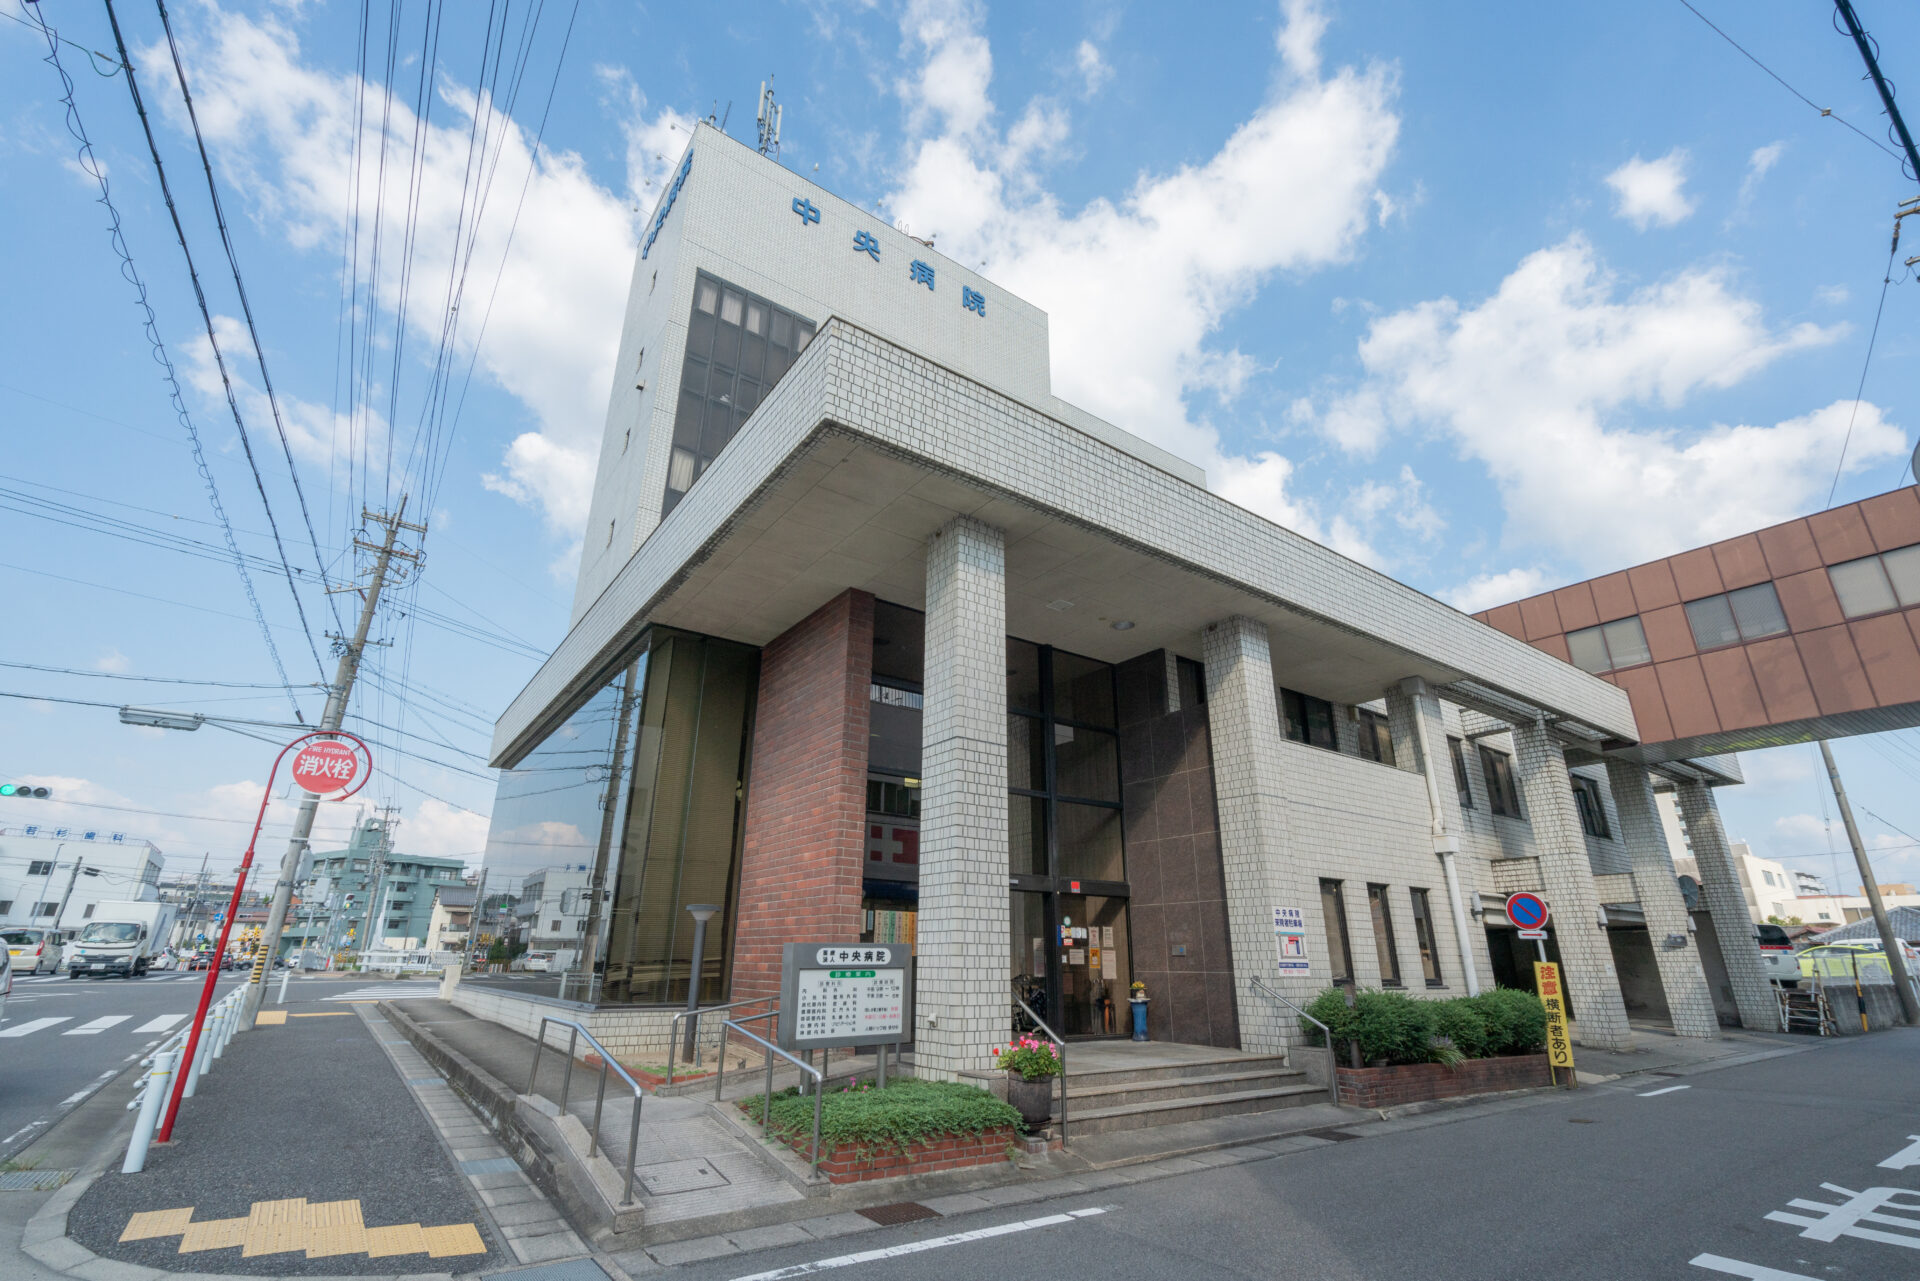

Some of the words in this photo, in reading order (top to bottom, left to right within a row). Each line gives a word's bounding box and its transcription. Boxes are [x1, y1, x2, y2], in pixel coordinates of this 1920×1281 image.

[791, 196, 986, 317] 中央病院
[308, 745, 322, 753] FIRE
[323, 747, 351, 756] HYDRANT
[297, 754, 354, 780] 消火栓
[1275, 909, 1300, 918] 中央病院
[839, 950, 886, 962] 中央病院
[1540, 965, 1558, 995] 注意
[1546, 998, 1568, 1064] 横断者あり
